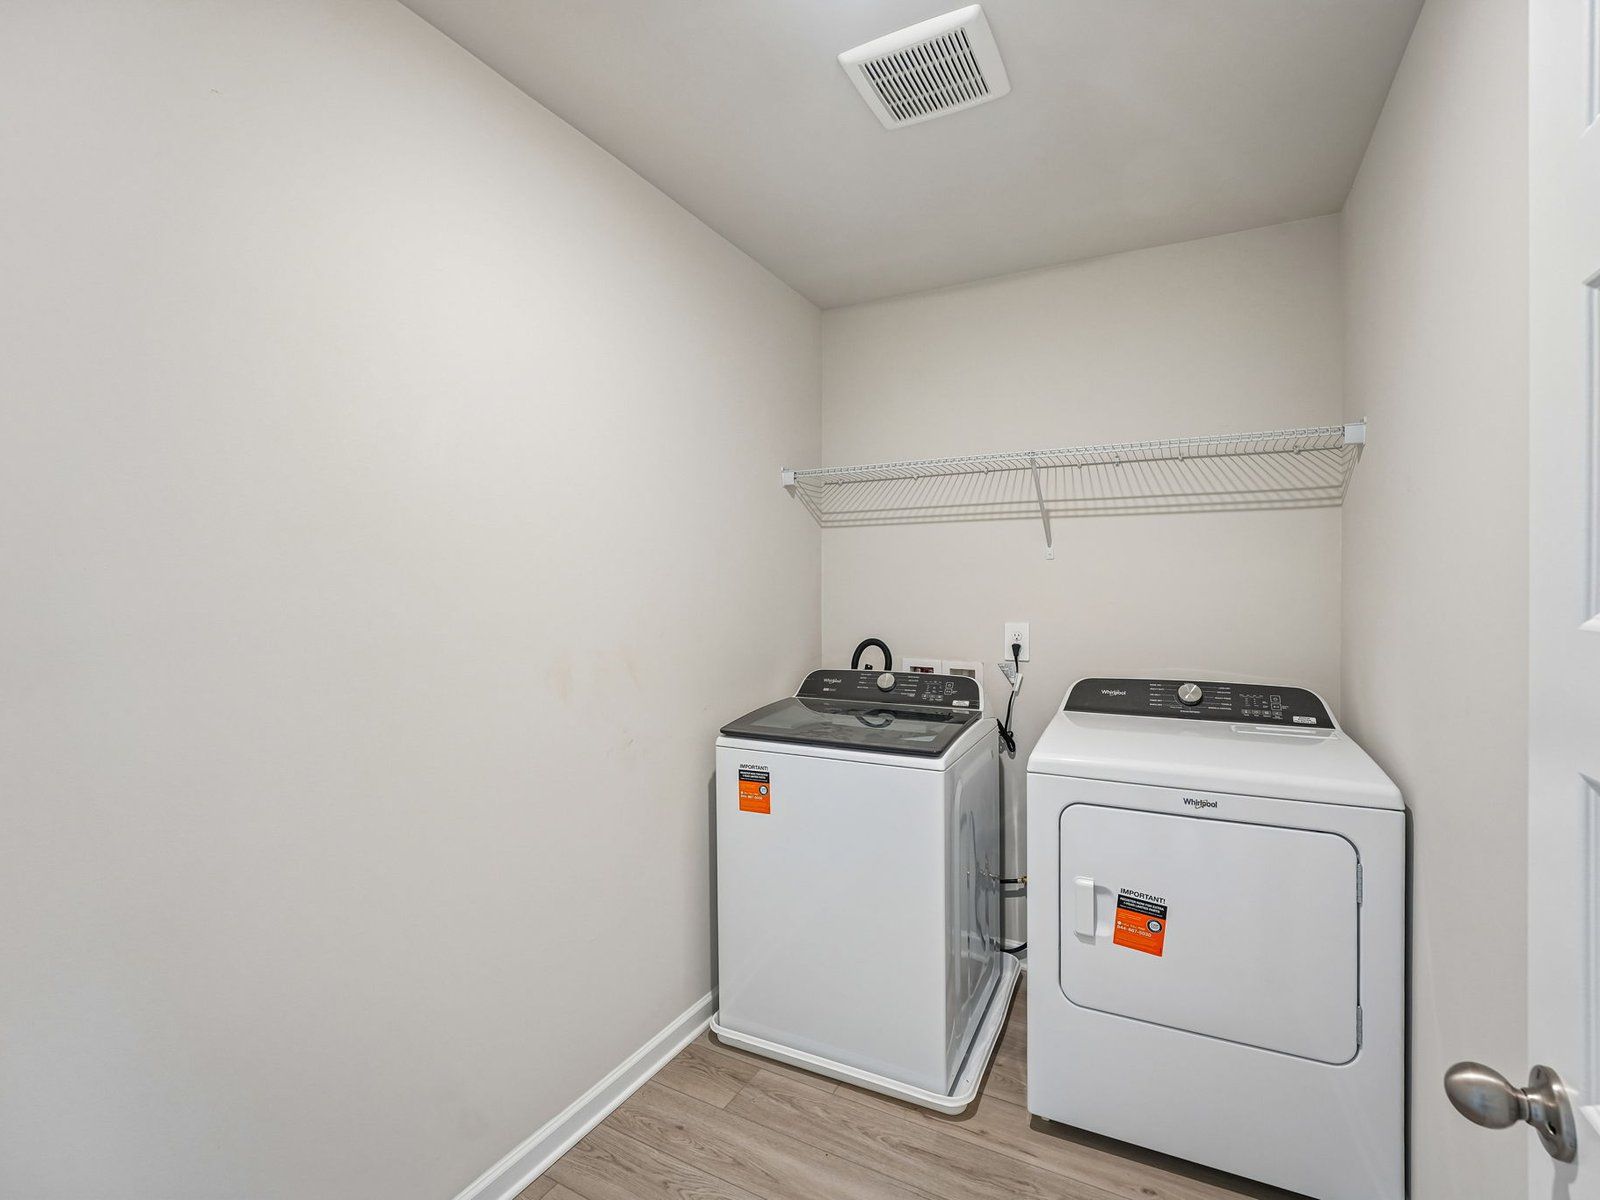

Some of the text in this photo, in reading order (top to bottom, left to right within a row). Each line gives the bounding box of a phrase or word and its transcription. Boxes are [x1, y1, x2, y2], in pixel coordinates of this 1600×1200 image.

[1100, 689, 1127, 697] Whirlpool
[1183, 797, 1218, 809] Whirlpool
[1120, 888, 1166, 904] IMPORTANT!
